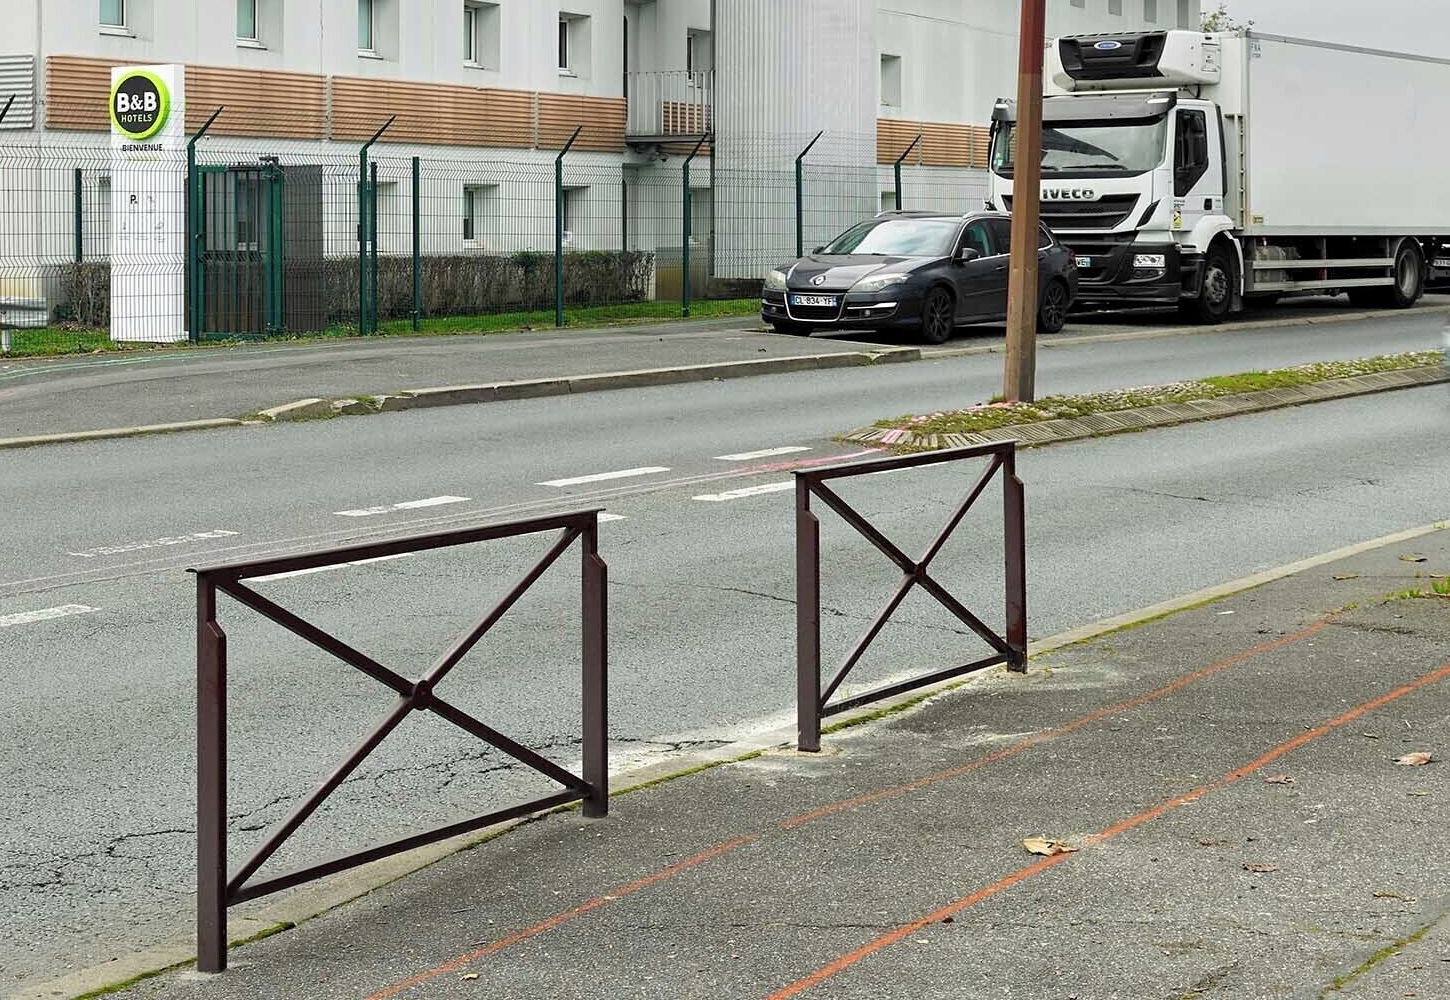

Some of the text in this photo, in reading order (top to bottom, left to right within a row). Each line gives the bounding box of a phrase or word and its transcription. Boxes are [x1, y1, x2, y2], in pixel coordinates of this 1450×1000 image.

[116, 91, 157, 113] B&B
[121, 113, 153, 123] HOTELS
[122, 143, 163, 152] BIENVENUE
[1042, 188, 1095, 200] IVECO
